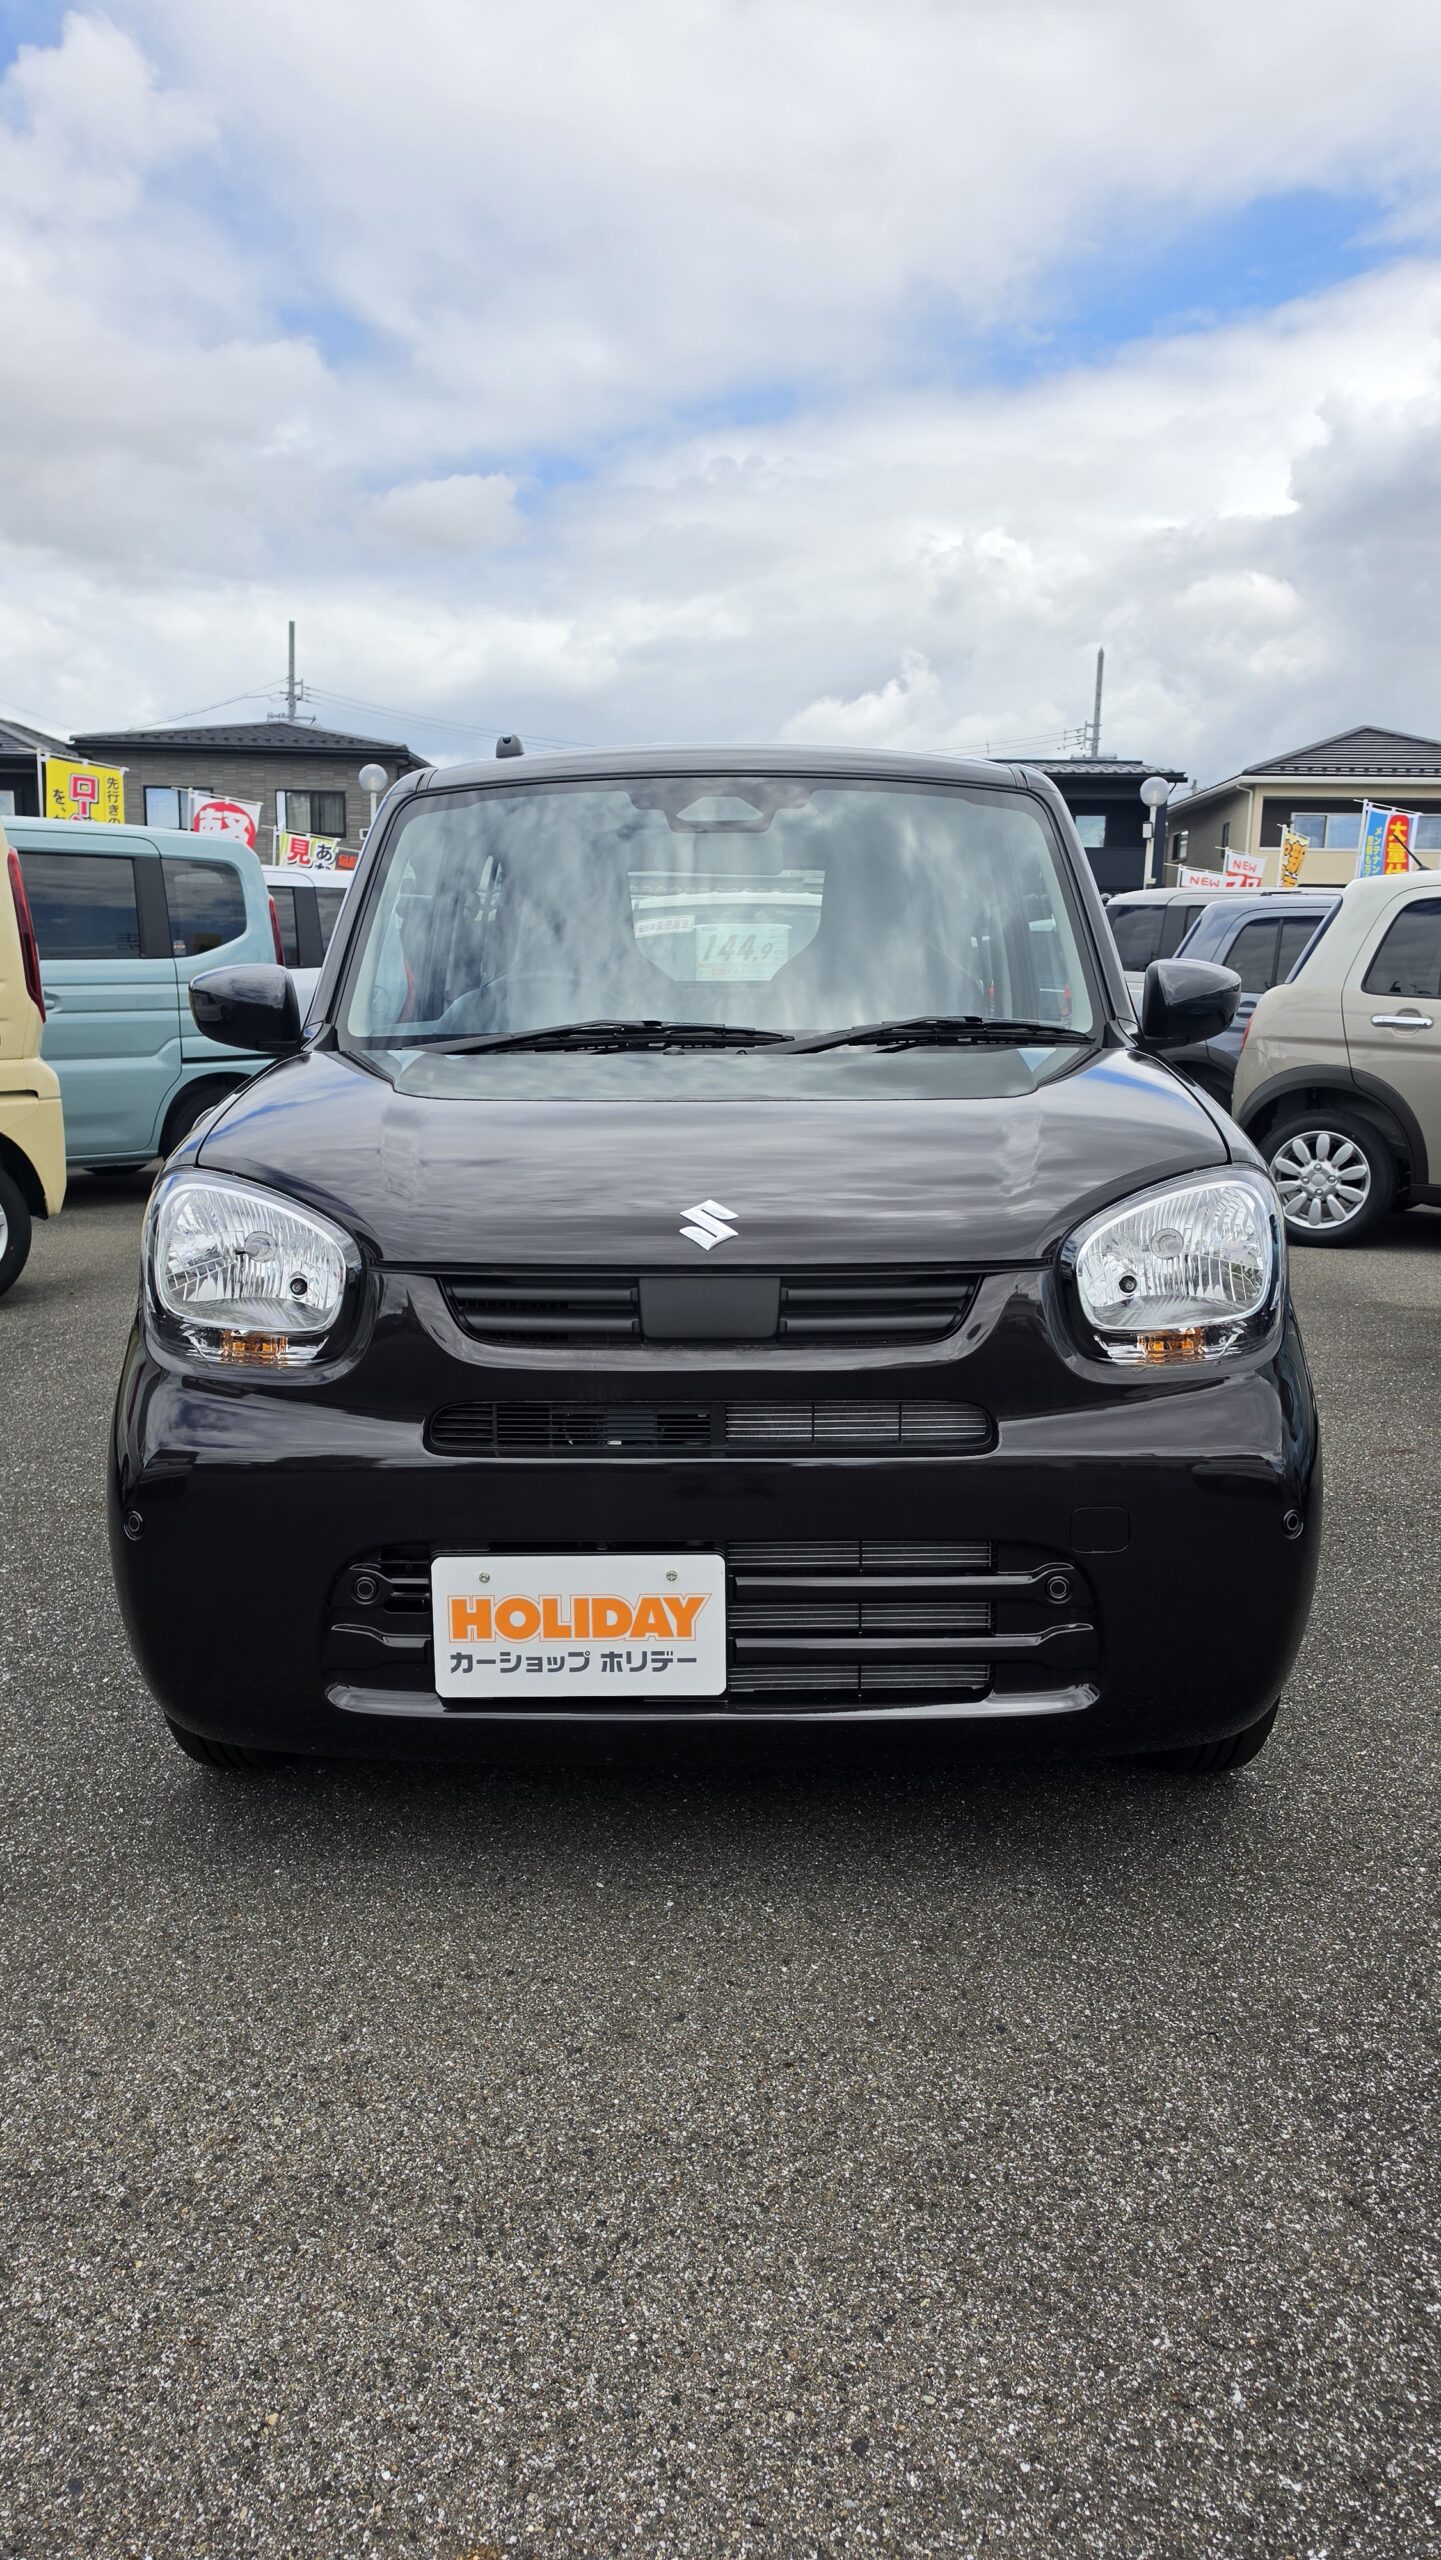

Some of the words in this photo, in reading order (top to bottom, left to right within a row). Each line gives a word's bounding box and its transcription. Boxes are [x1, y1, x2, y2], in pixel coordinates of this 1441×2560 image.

[287, 836, 311, 866] 見
[1232, 859, 1258, 873] NEW
[1189, 875, 1220, 888] NEW
[702, 933, 774, 962] 144.9
[448, 1593, 711, 1643] HOLIDAY
[450, 1650, 591, 1674] カーショップ
[600, 1650, 698, 1673] ホリデー
